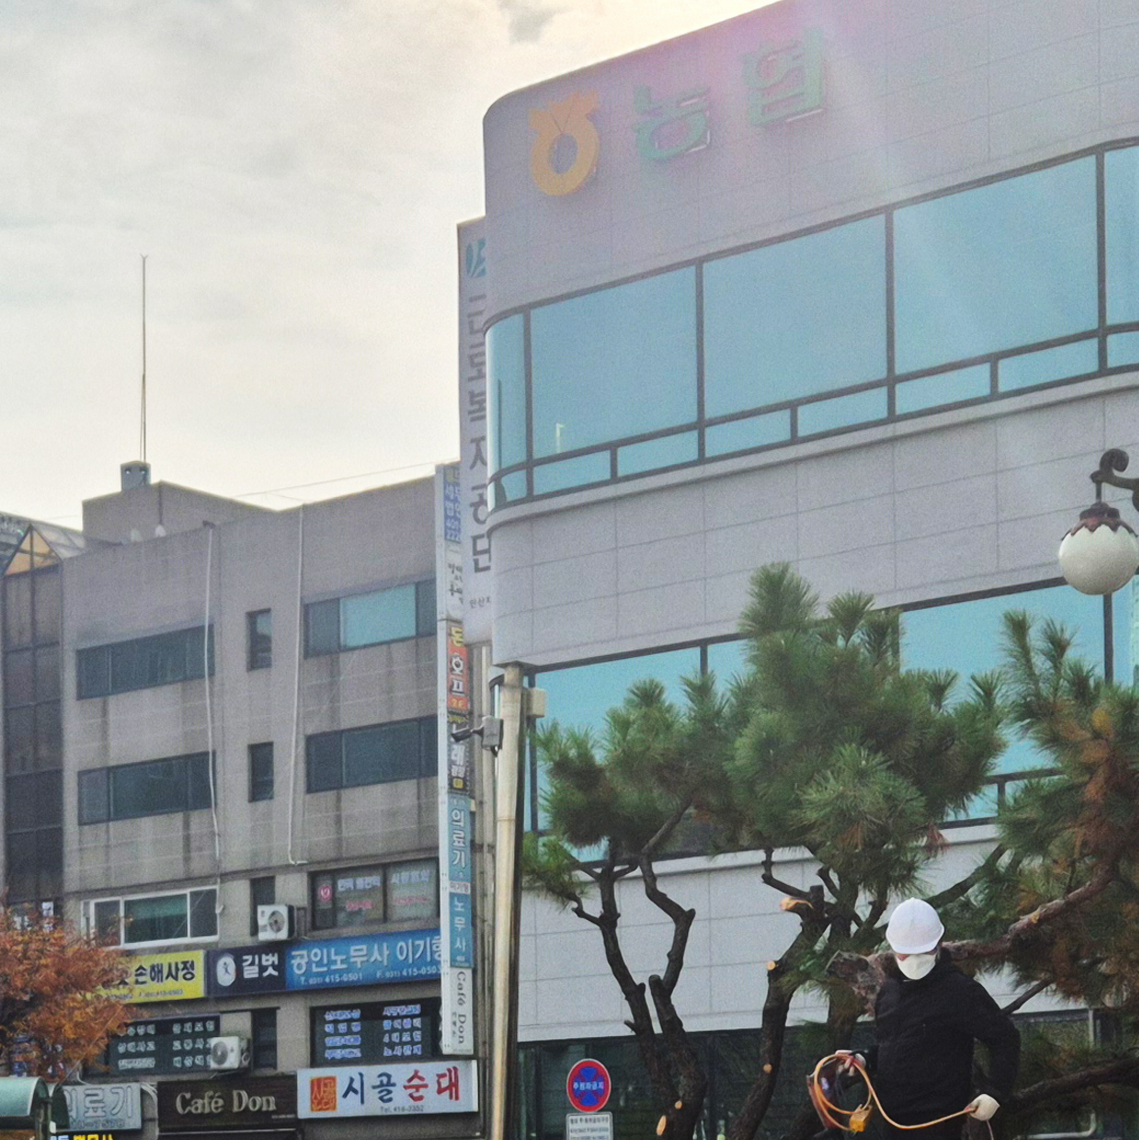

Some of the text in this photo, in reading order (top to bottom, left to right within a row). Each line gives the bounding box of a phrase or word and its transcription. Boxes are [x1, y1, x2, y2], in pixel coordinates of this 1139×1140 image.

[452, 809, 466, 868] 의료기
[134, 960, 196, 986] 손해사정
[242, 953, 279, 979] 길벗
[291, 943, 390, 975] 공인노무사
[342, 1066, 460, 1105] 시골 순대
[175, 1090, 276, 1115] Café Don
